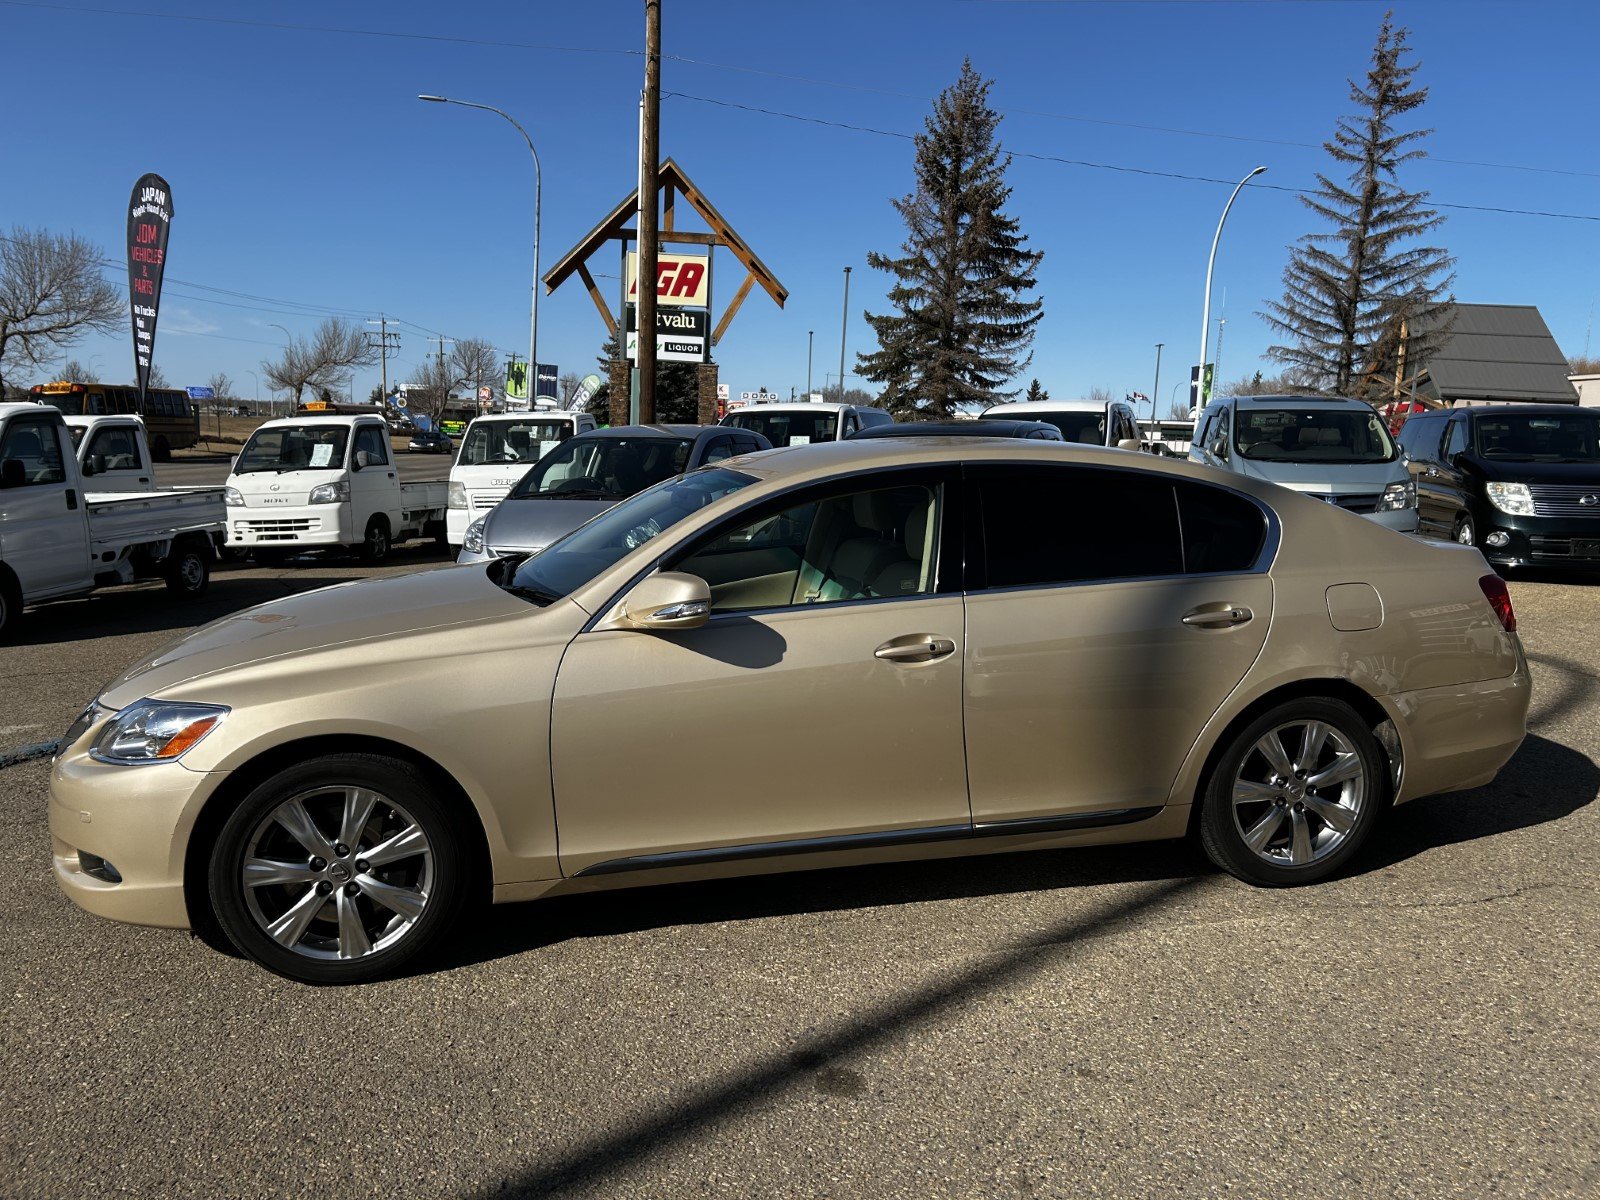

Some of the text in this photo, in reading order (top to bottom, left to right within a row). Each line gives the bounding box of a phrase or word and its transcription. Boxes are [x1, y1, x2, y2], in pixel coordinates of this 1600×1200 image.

[141, 187, 166, 206] JAPAN
[136, 224, 157, 244] JDM
[131, 246, 163, 264] VEHICLES
[135, 278, 153, 295] PARTS
[663, 313, 696, 329] valu
[668, 344, 699, 353] LIQUOR
